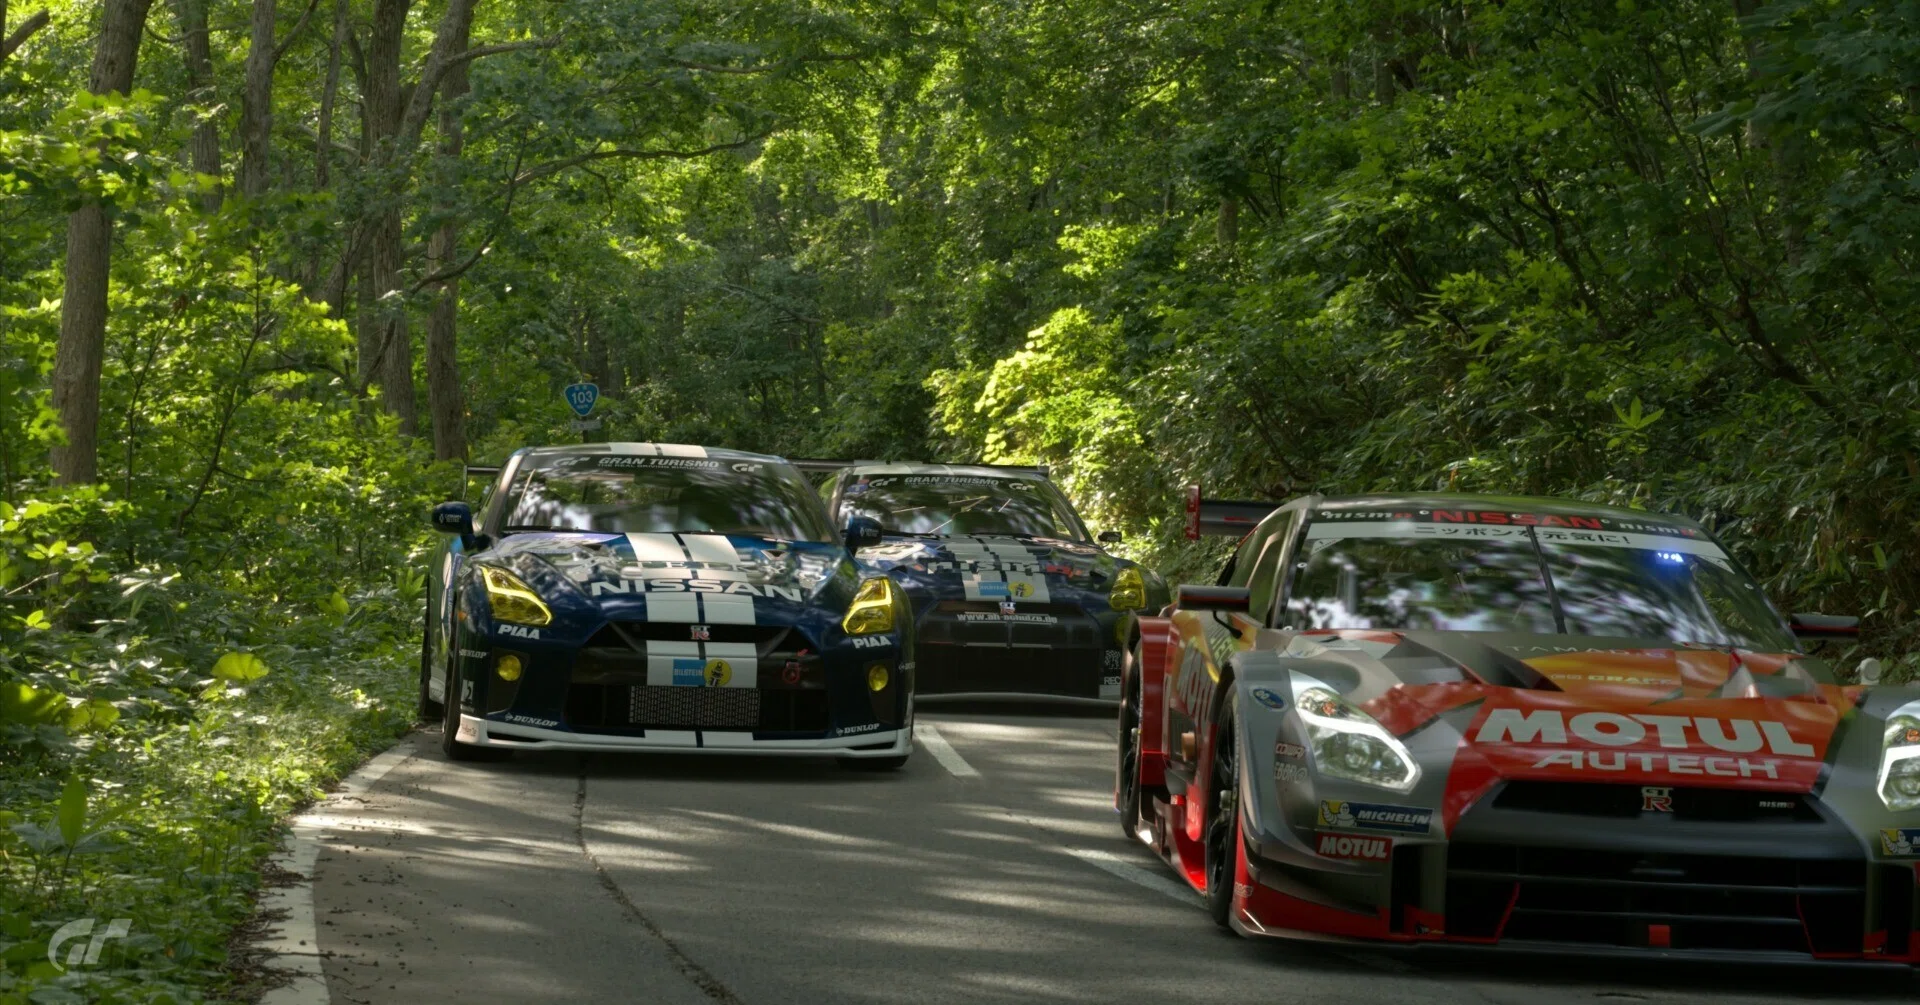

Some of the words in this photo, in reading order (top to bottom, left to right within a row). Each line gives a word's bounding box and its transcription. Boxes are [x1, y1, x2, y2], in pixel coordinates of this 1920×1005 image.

[571, 390, 593, 404] 103
[598, 457, 645, 465] GRAN
[650, 458, 719, 468] TURISMO
[904, 476, 942, 484] GRAN
[944, 476, 999, 486] TURISMO
[1432, 509, 1604, 530] NISSAN
[591, 578, 803, 602] NISSAN
[498, 624, 540, 640] PIAA
[852, 636, 892, 649] PIAA
[512, 715, 558, 727] DUNLOP
[844, 723, 880, 734] DUNLOP
[1475, 708, 1816, 757] MOTUL
[1531, 750, 1779, 780] AUTECH
[1758, 800, 1796, 809] nismo
[1358, 810, 1430, 825] MICHELIN
[1319, 836, 1388, 859] MOTUL
